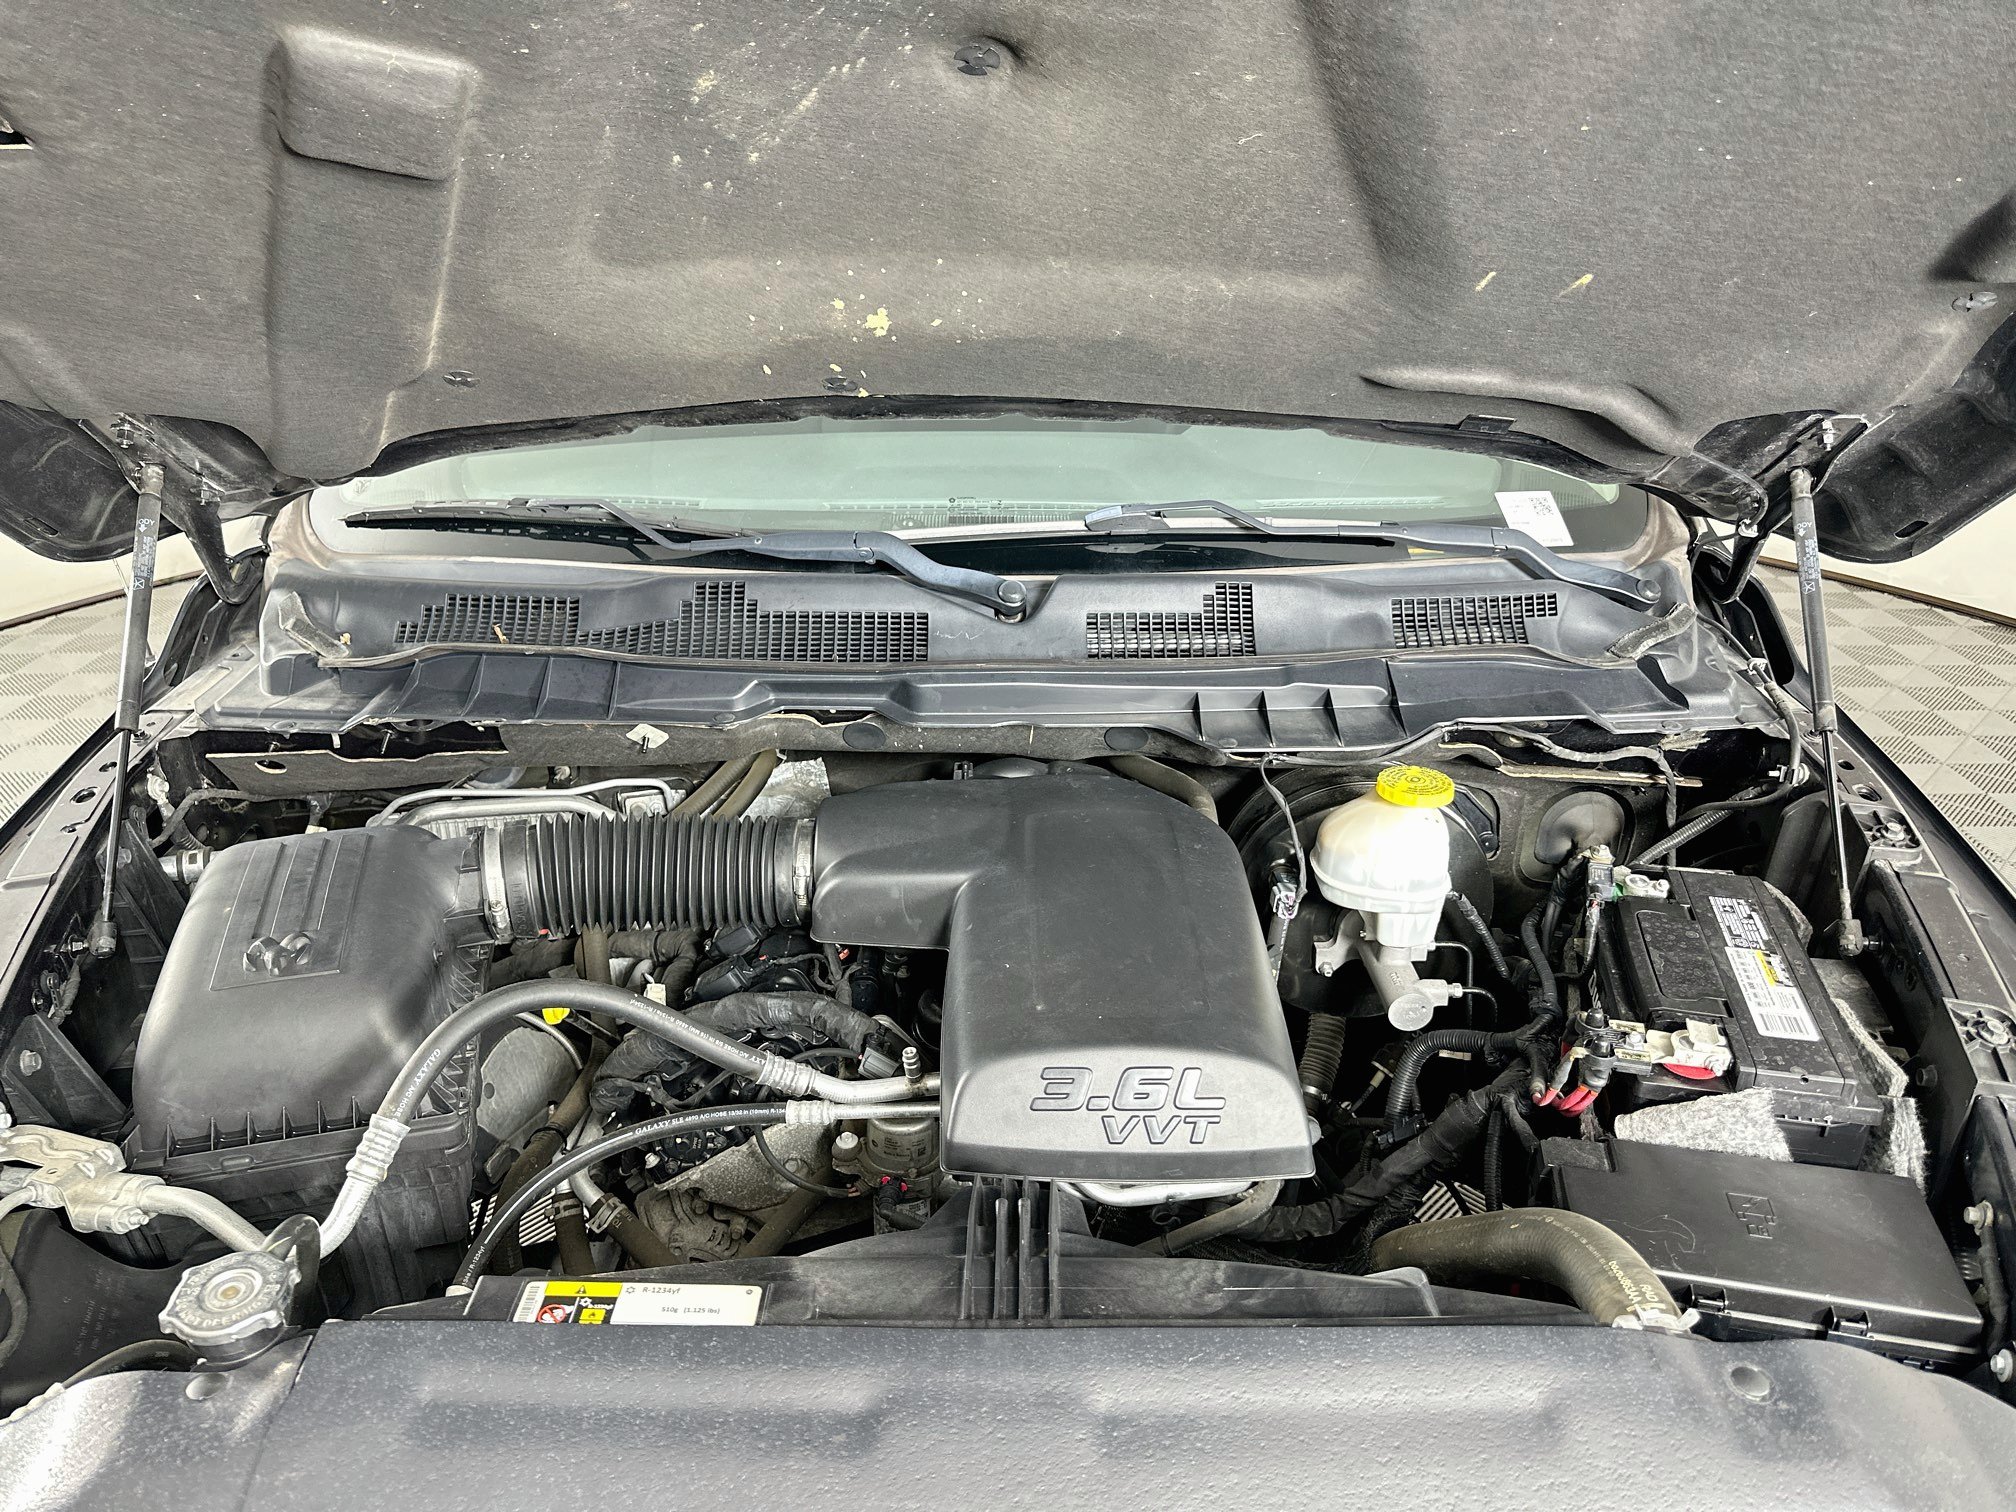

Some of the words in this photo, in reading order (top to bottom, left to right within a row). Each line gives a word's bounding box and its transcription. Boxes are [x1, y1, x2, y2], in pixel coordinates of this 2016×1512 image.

[724, 1042, 740, 1054] HOSE
[414, 1048, 441, 1086] GALAXY
[405, 1085, 416, 1098] A/C
[1029, 1066, 1226, 1111] 3.6L
[393, 1097, 410, 1118] HOSE
[634, 1119, 671, 1135] GALAXY
[671, 1116, 685, 1125] SLE
[699, 1112, 710, 1120] A/C
[710, 1110, 727, 1118] HOSE
[1101, 1115, 1221, 1144] VVT
[642, 1286, 681, 1295] R-1234yf
[661, 1306, 679, 1314] 510g
